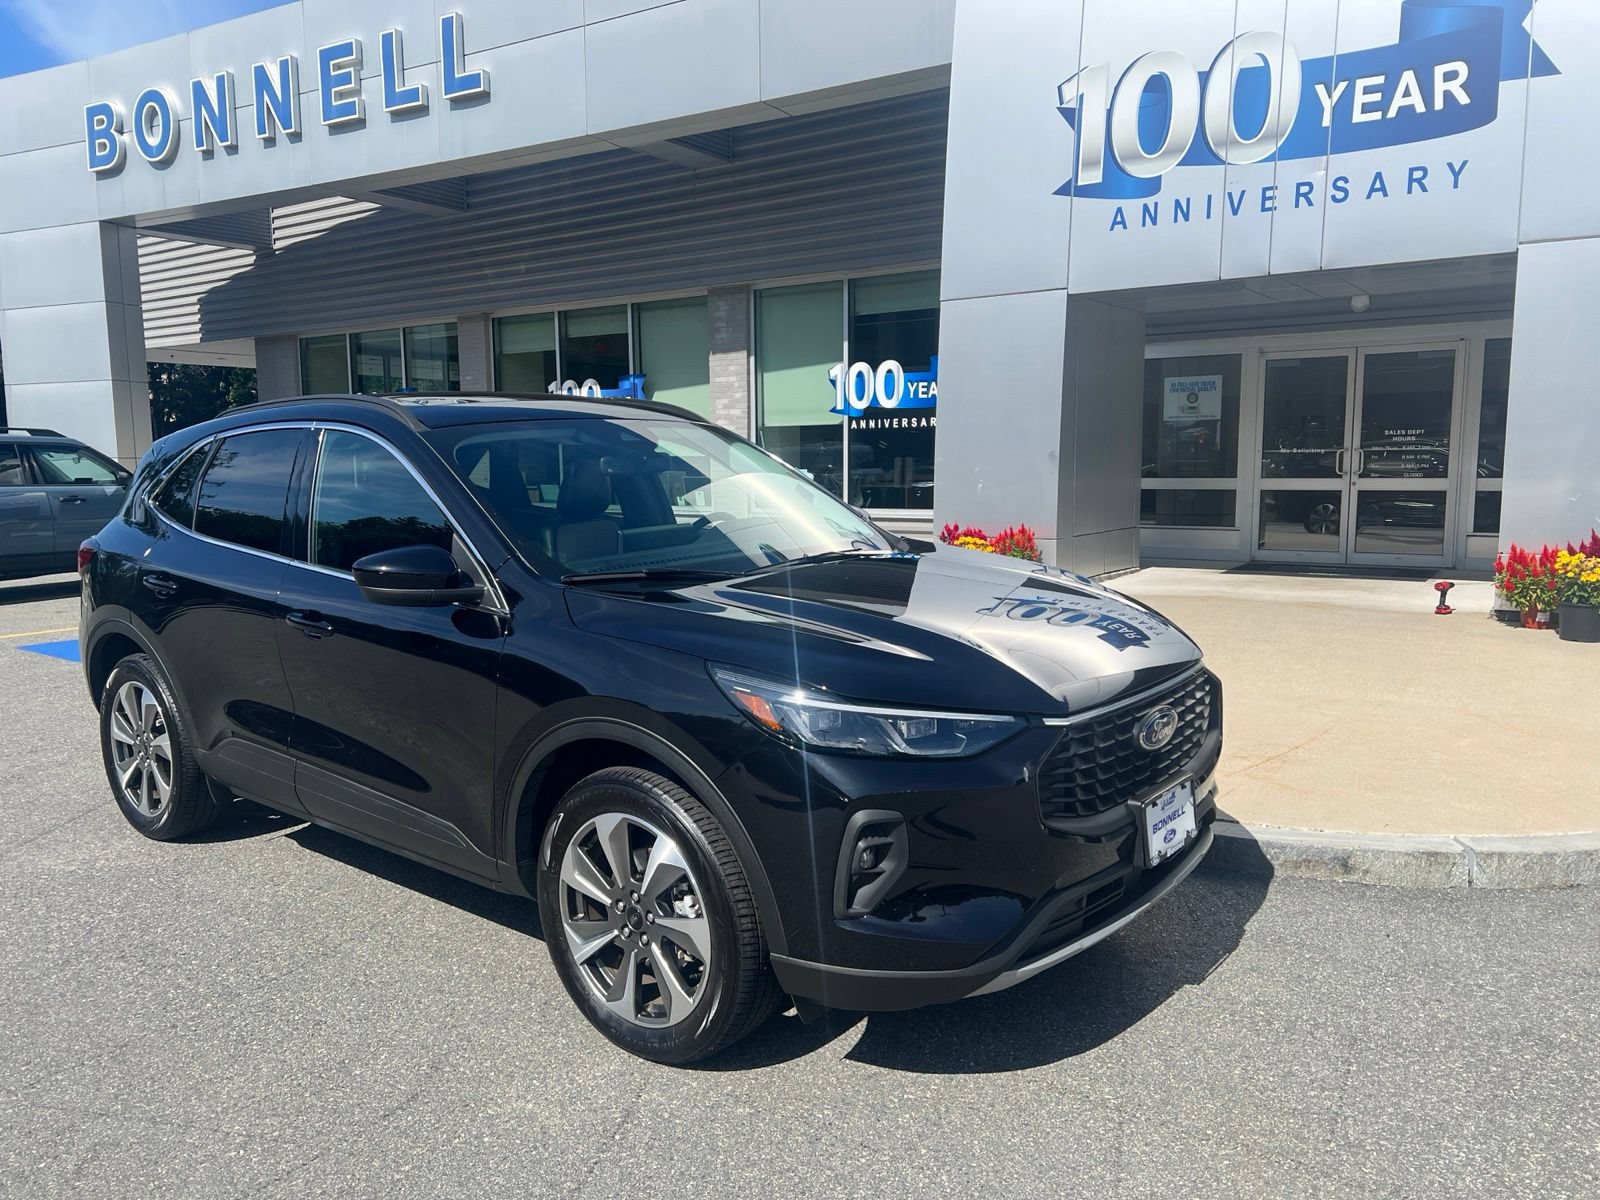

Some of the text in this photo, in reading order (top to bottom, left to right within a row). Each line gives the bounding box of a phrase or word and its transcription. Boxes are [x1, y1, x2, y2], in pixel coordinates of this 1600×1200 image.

[84, 12, 490, 173] BONNELL
[1059, 31, 1472, 186] 100 YEAR
[1109, 159, 1471, 232] ANNIVERSARY
[829, 360, 938, 410] 100 YEA
[850, 417, 936, 430] ANNIVERSAR
[1152, 805, 1186, 835] BONNELL
